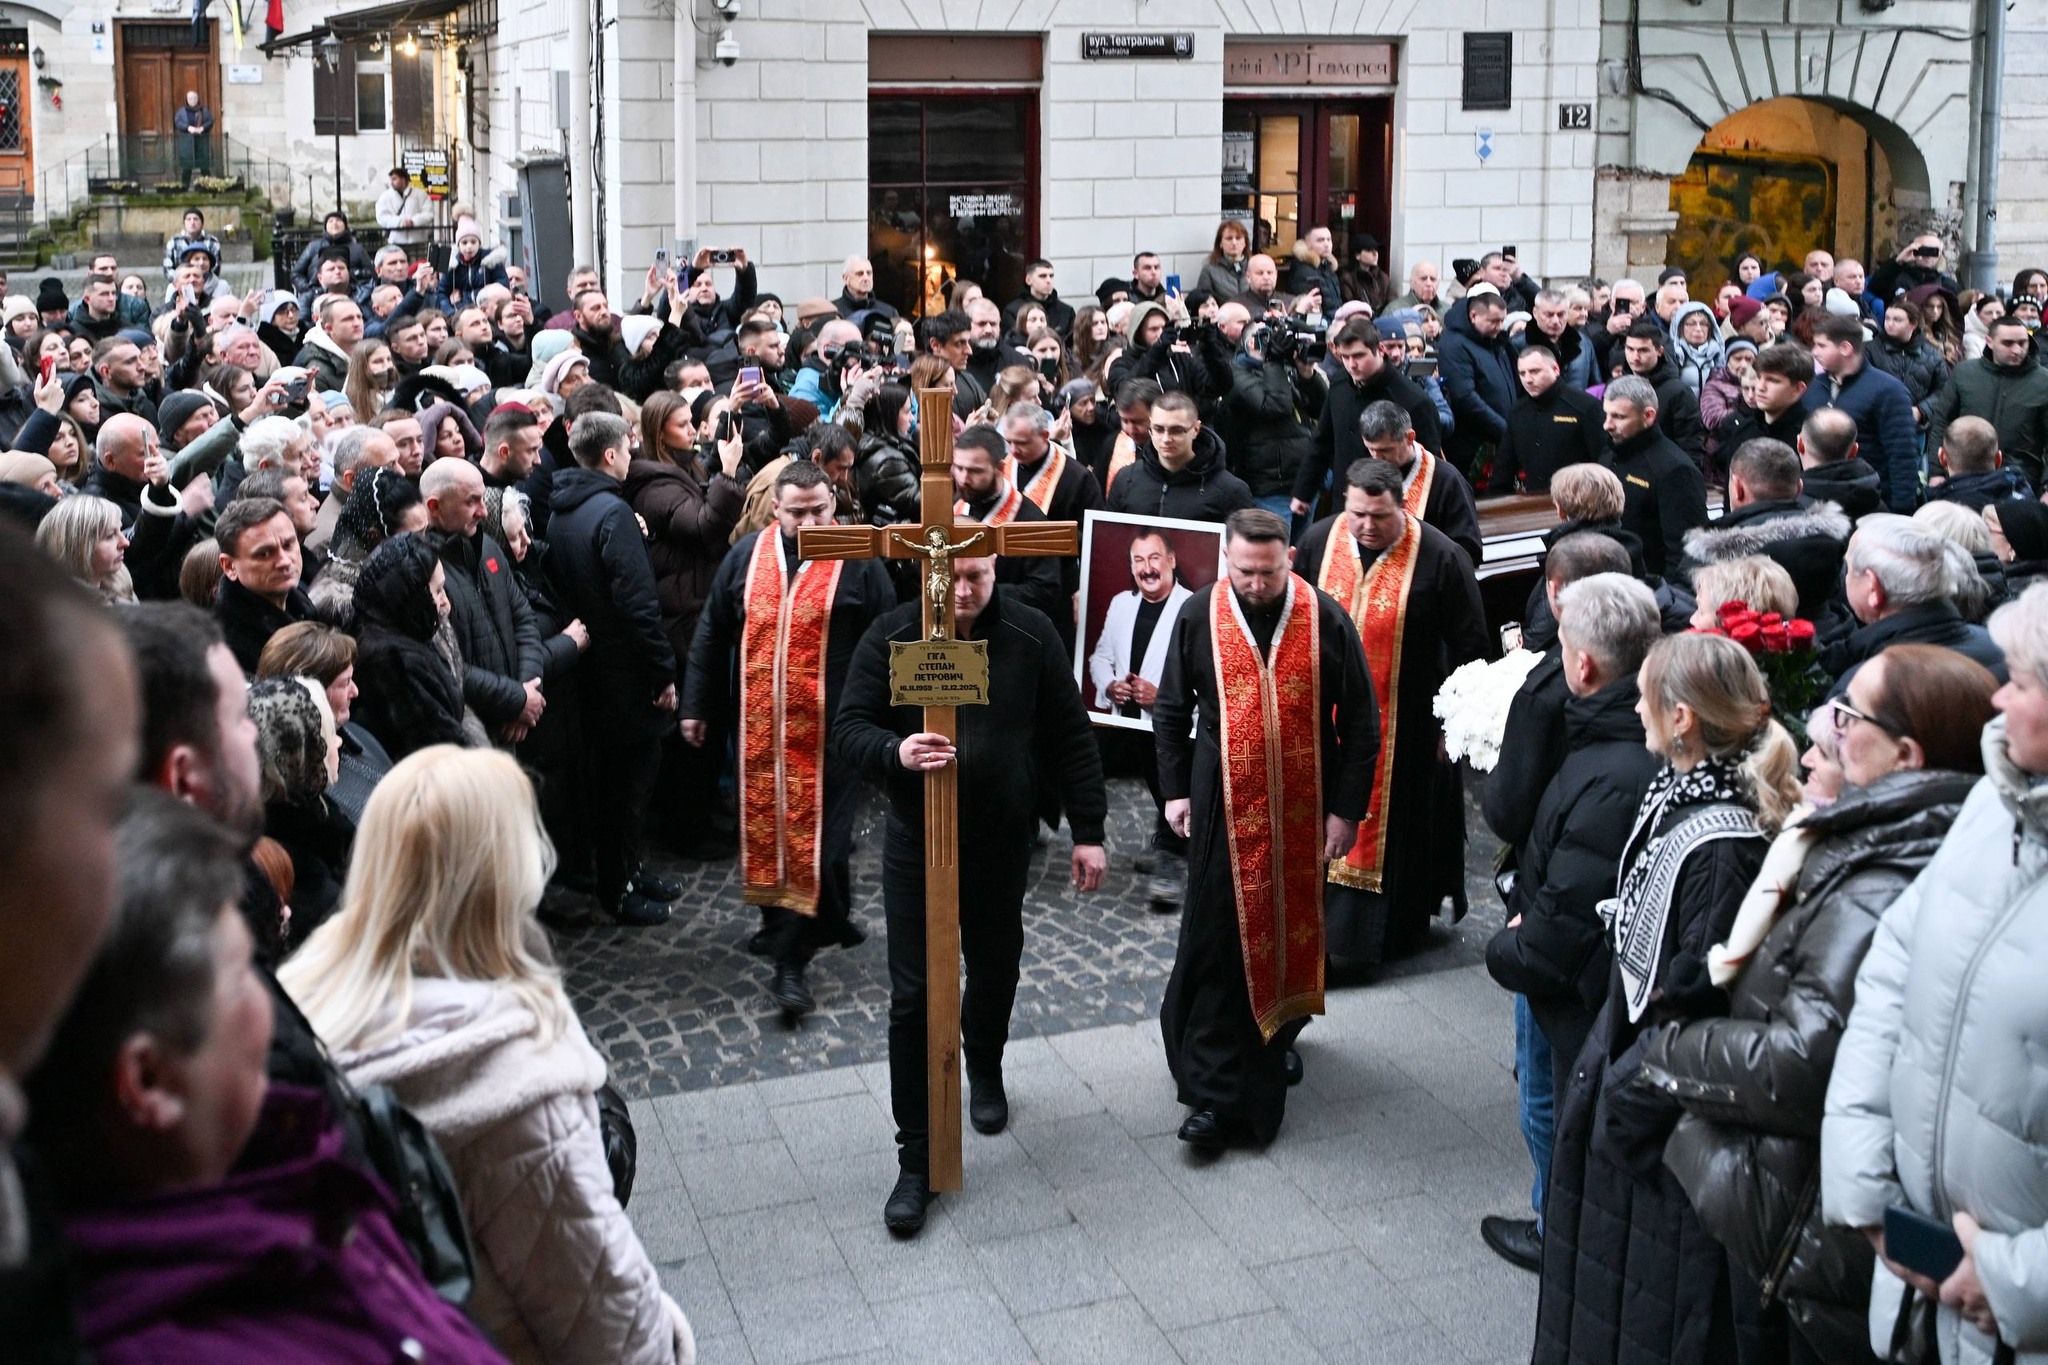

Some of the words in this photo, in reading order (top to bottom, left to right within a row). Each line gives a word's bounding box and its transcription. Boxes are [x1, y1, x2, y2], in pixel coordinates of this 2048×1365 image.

[1089, 36, 1108, 48] вул.
[1110, 35, 1165, 48] Театральна
[1267, 51, 1317, 75] АРТ
[1318, 62, 1388, 80] галерея
[1565, 105, 1588, 127] 12
[927, 652, 946, 660] ГІГА
[918, 662, 955, 671] СТЕПАН
[914, 673, 963, 681] ПЕТРОВИЧ
